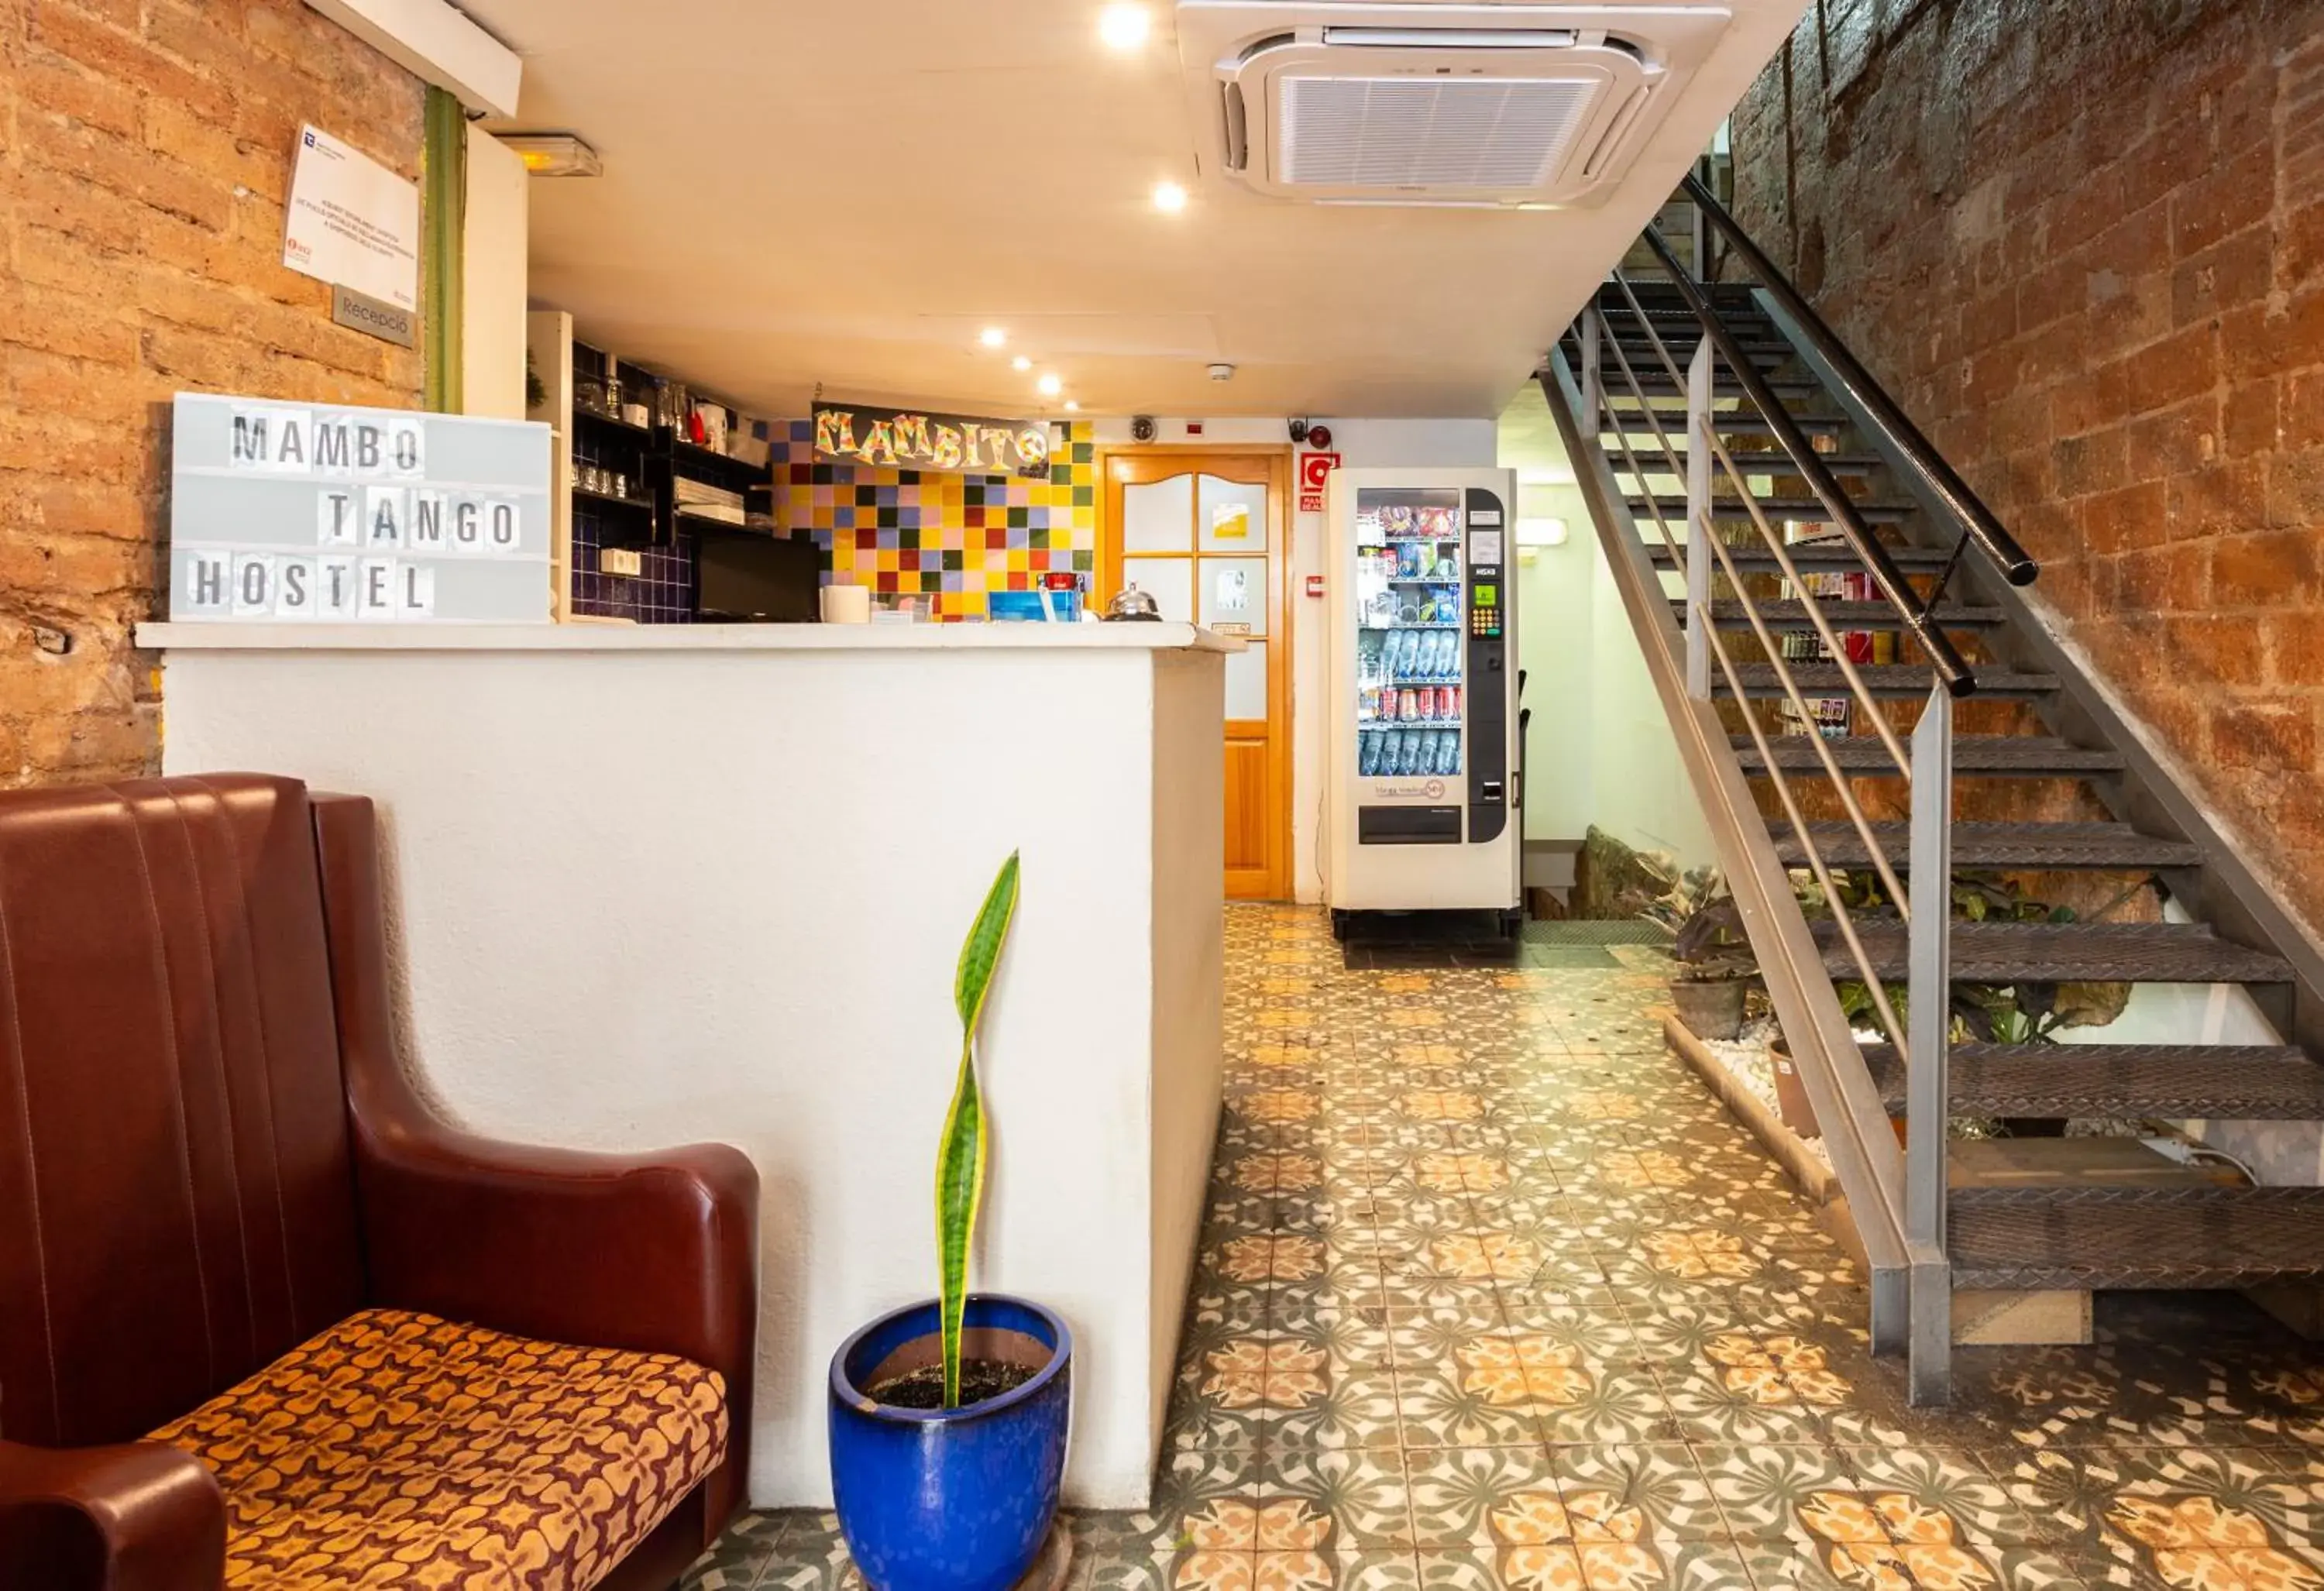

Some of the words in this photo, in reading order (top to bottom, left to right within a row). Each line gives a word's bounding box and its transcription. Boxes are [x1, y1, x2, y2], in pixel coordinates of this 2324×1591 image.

[343, 297, 408, 335] Recepció
[233, 416, 418, 470] MAMBO
[814, 408, 1048, 471] MAMBITO
[328, 494, 513, 545] TANGO
[195, 560, 425, 609] HOSTEL
